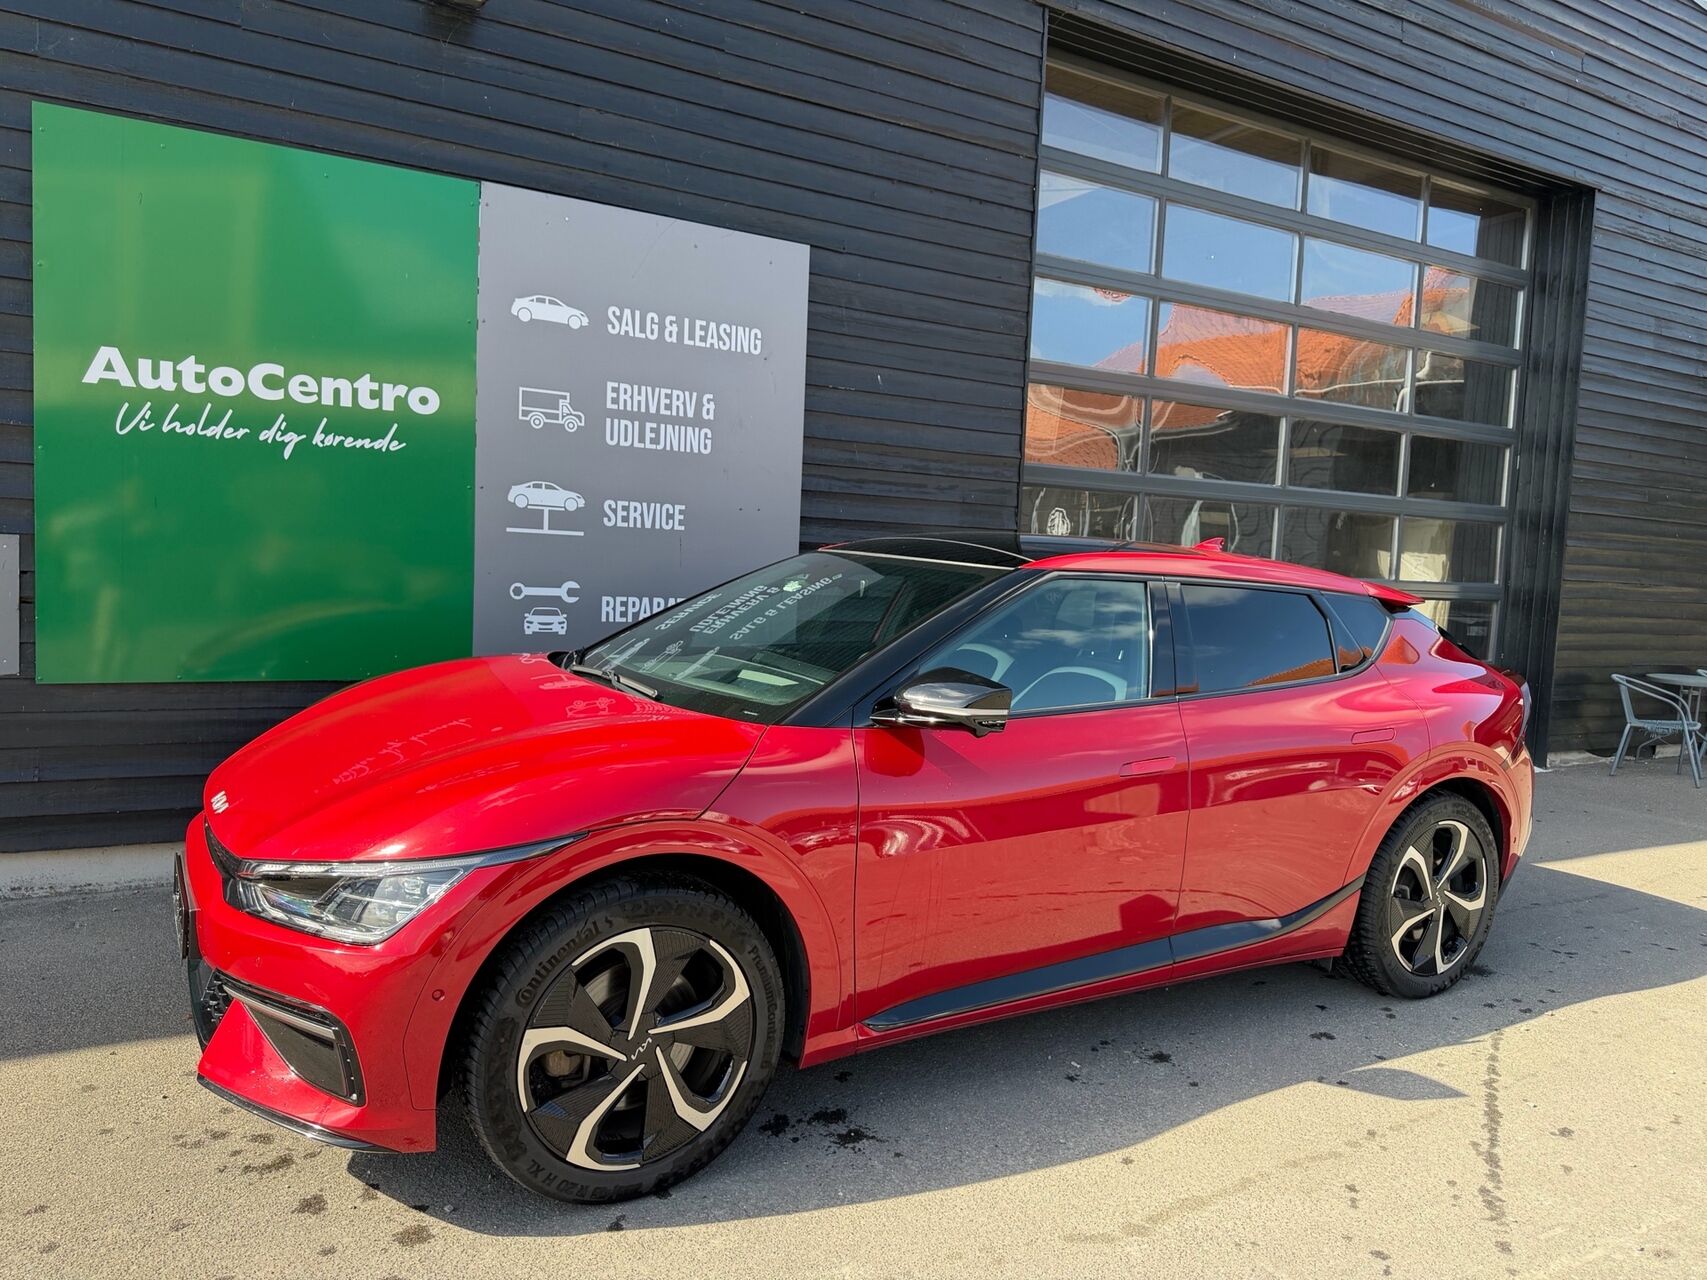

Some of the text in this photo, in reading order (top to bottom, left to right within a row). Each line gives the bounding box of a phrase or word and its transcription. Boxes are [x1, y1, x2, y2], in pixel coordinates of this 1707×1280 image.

[606, 306, 762, 355] SALG & LEASING
[82, 346, 441, 415] AutoCentro
[606, 381, 716, 421] ERHVERV &
[115, 402, 407, 460] Vi holder dig kørende
[605, 418, 713, 455] UDLEJNING
[603, 500, 686, 531] SERVICE
[601, 596, 687, 622] REPAR
